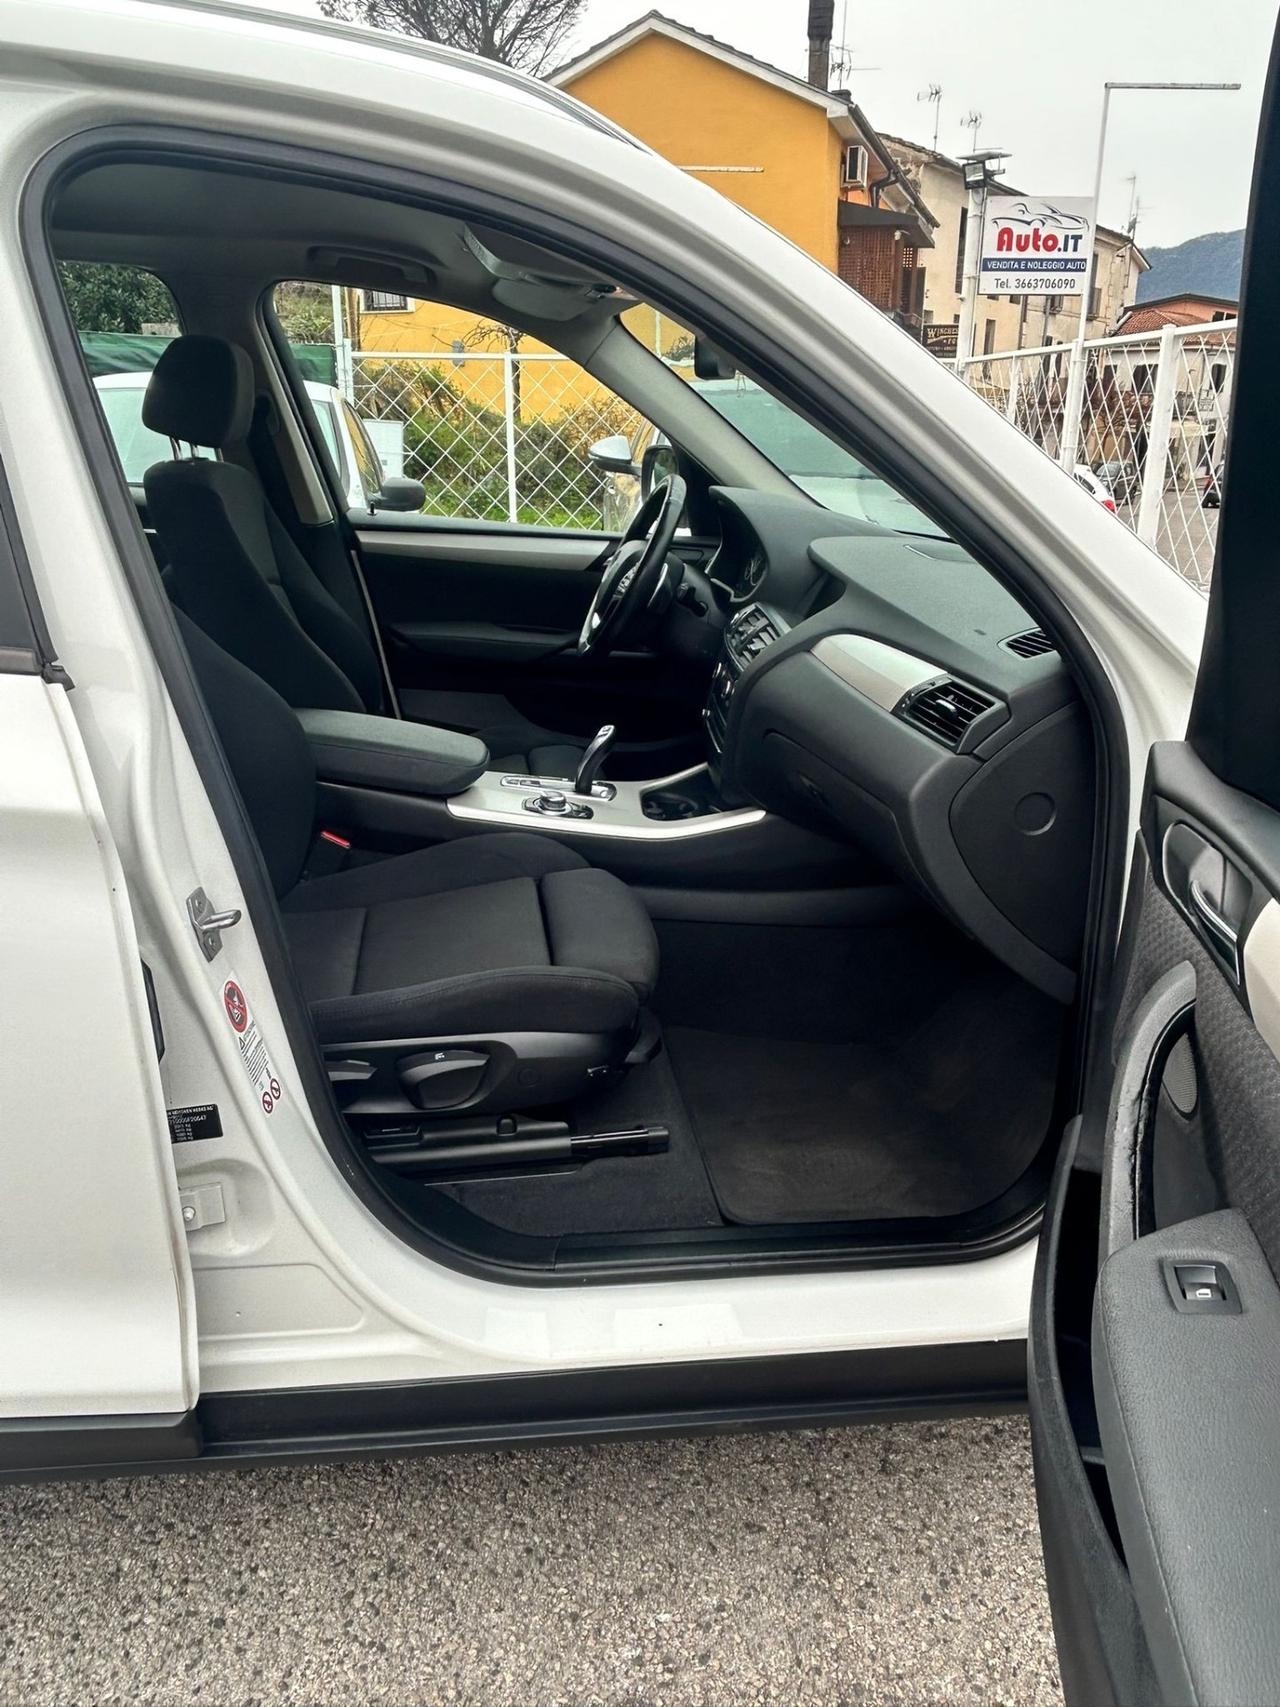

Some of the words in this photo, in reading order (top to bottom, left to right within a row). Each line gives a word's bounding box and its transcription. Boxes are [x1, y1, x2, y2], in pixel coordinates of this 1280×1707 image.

[996, 227, 1083, 252] Auto.IT
[987, 261, 1018, 269] VENDITA
[1020, 261, 1026, 269] E
[1027, 261, 1065, 269] NOLEGGIO
[1066, 261, 1087, 270] AUTO
[994, 278, 1012, 289] Tel.
[1014, 278, 1076, 289] 3663706090
